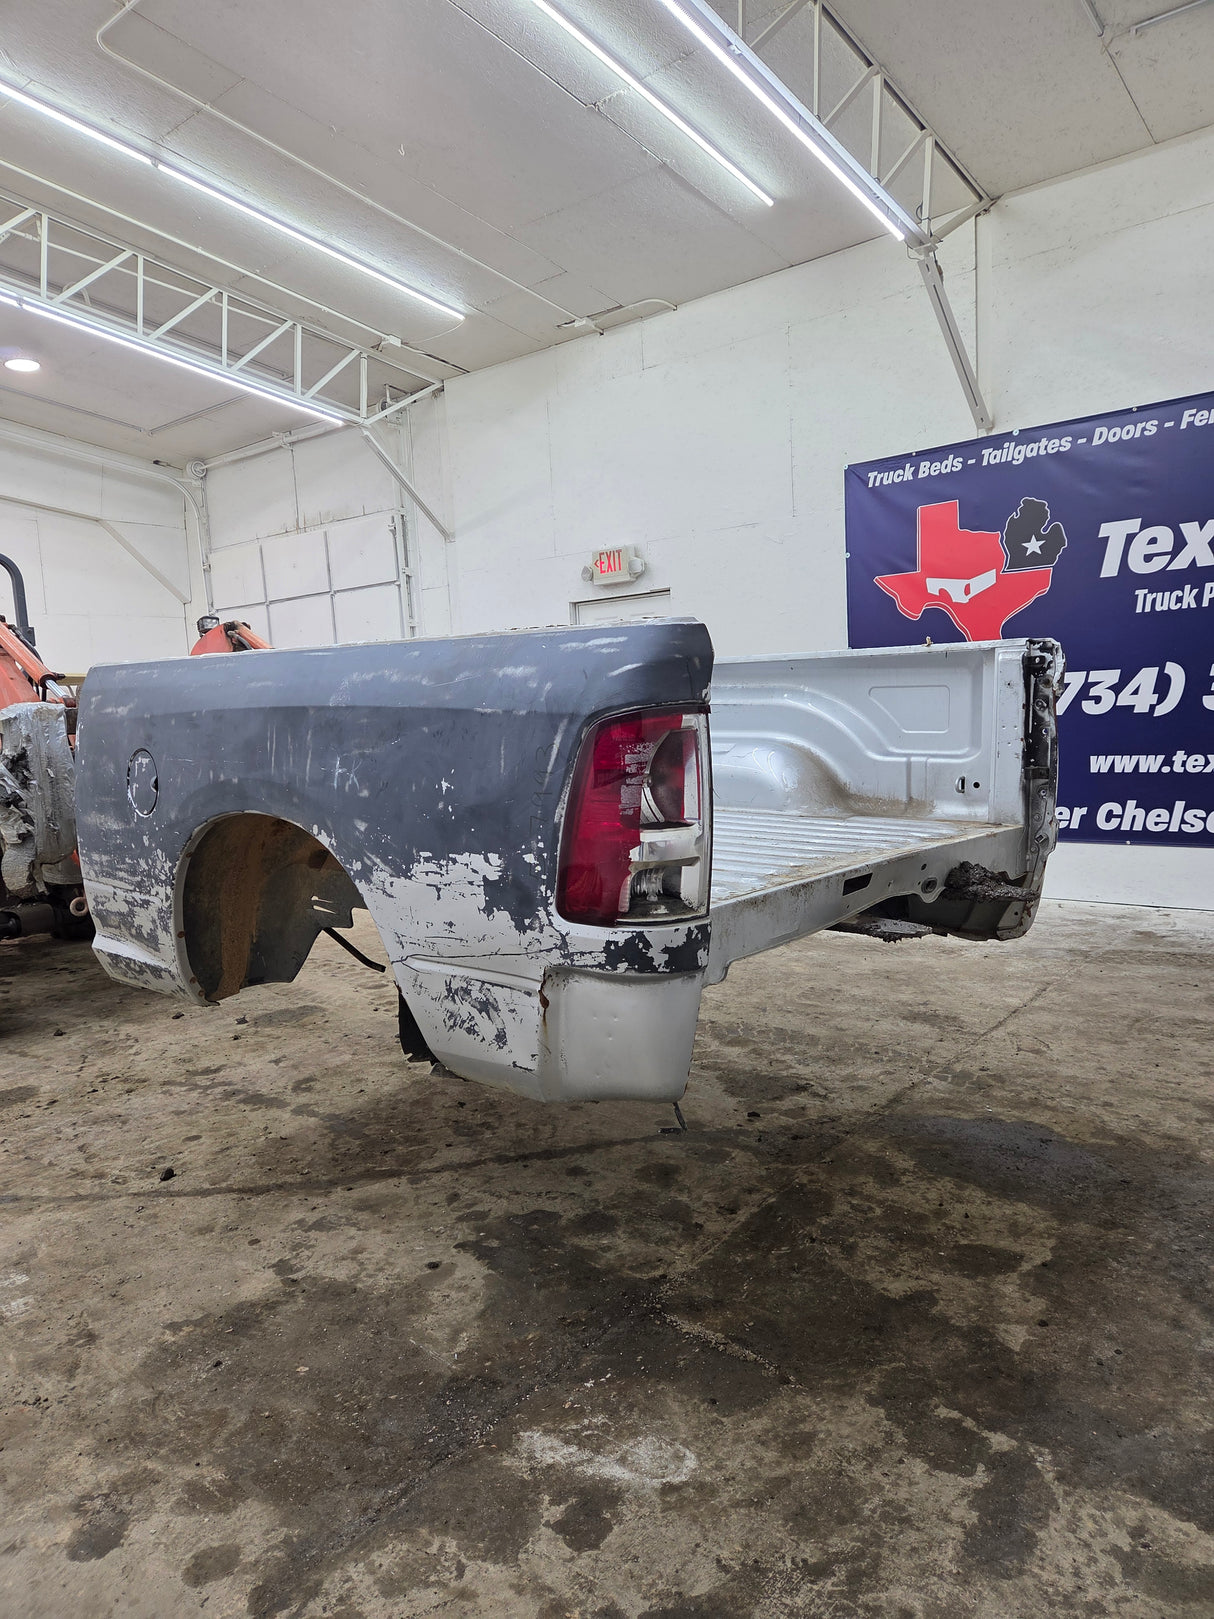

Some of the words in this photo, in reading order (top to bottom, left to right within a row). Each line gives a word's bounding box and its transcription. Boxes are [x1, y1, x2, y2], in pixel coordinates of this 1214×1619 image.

[867, 464, 916, 488] Truck
[918, 454, 963, 479] Beds
[981, 437, 1073, 466] Tailgates
[1092, 419, 1158, 446] Doors
[599, 549, 622, 574] EXIT
[1134, 584, 1199, 613] Truck
